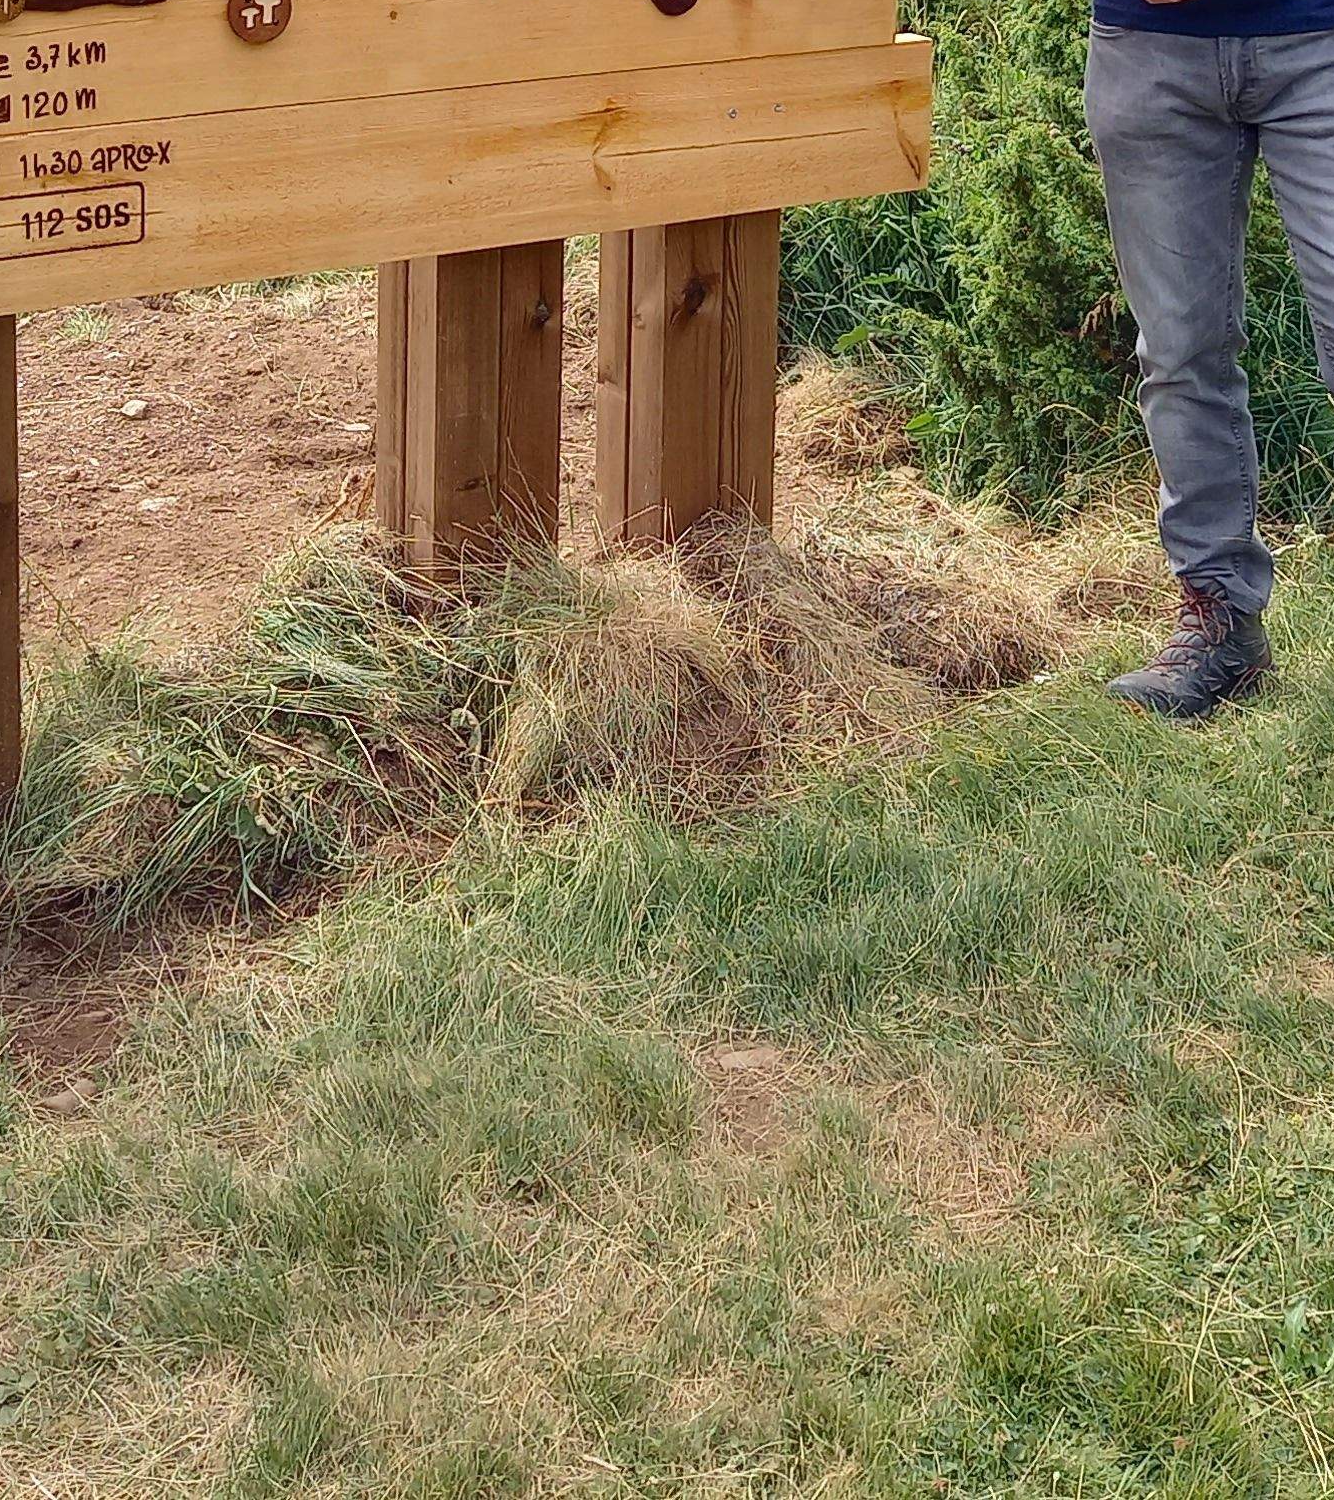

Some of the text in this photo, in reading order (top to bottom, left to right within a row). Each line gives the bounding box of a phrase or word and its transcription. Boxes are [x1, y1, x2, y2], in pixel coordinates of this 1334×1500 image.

[25, 45, 60, 74] 3,7
[22, 91, 68, 119] 120
[19, 150, 83, 180] 1h30
[21, 201, 131, 241] 112 SOS
